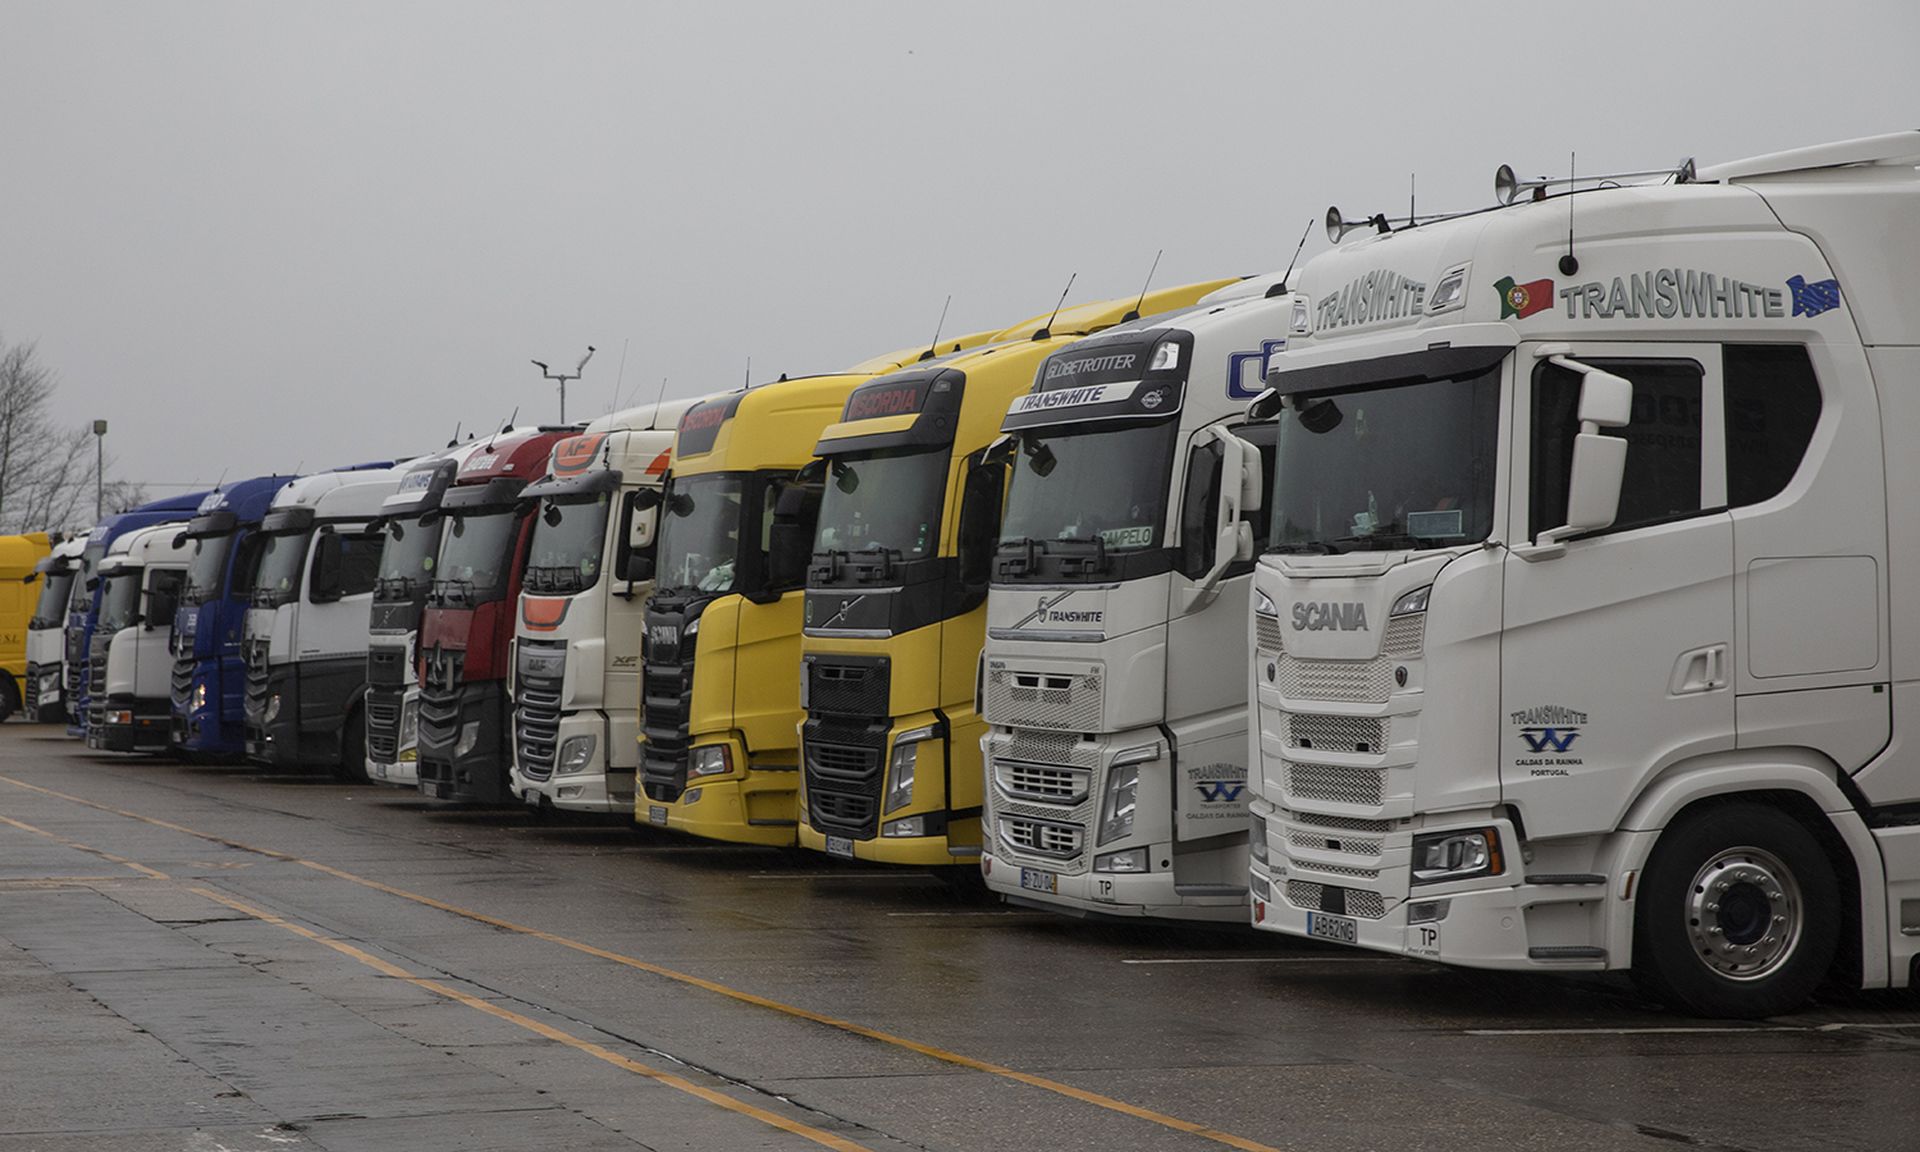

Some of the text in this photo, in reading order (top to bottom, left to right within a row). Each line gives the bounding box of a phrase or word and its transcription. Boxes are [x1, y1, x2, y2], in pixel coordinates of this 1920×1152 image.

[1316, 269, 1425, 331] TRANSWHITE
[1560, 268, 1784, 319] TRANSWHITE
[1047, 354, 1136, 379] GLOBETROTTER
[1019, 386, 1107, 411] TRANSWHITE
[1049, 611, 1103, 622] TRANSWHITE
[1292, 601, 1369, 631] SCANIA
[613, 656, 639, 664] XF
[1510, 704, 1588, 725] TRANSWHITE
[1187, 763, 1249, 780] TRANSWHIT
[1099, 880, 1112, 895] TP
[1420, 927, 1437, 947] TP
